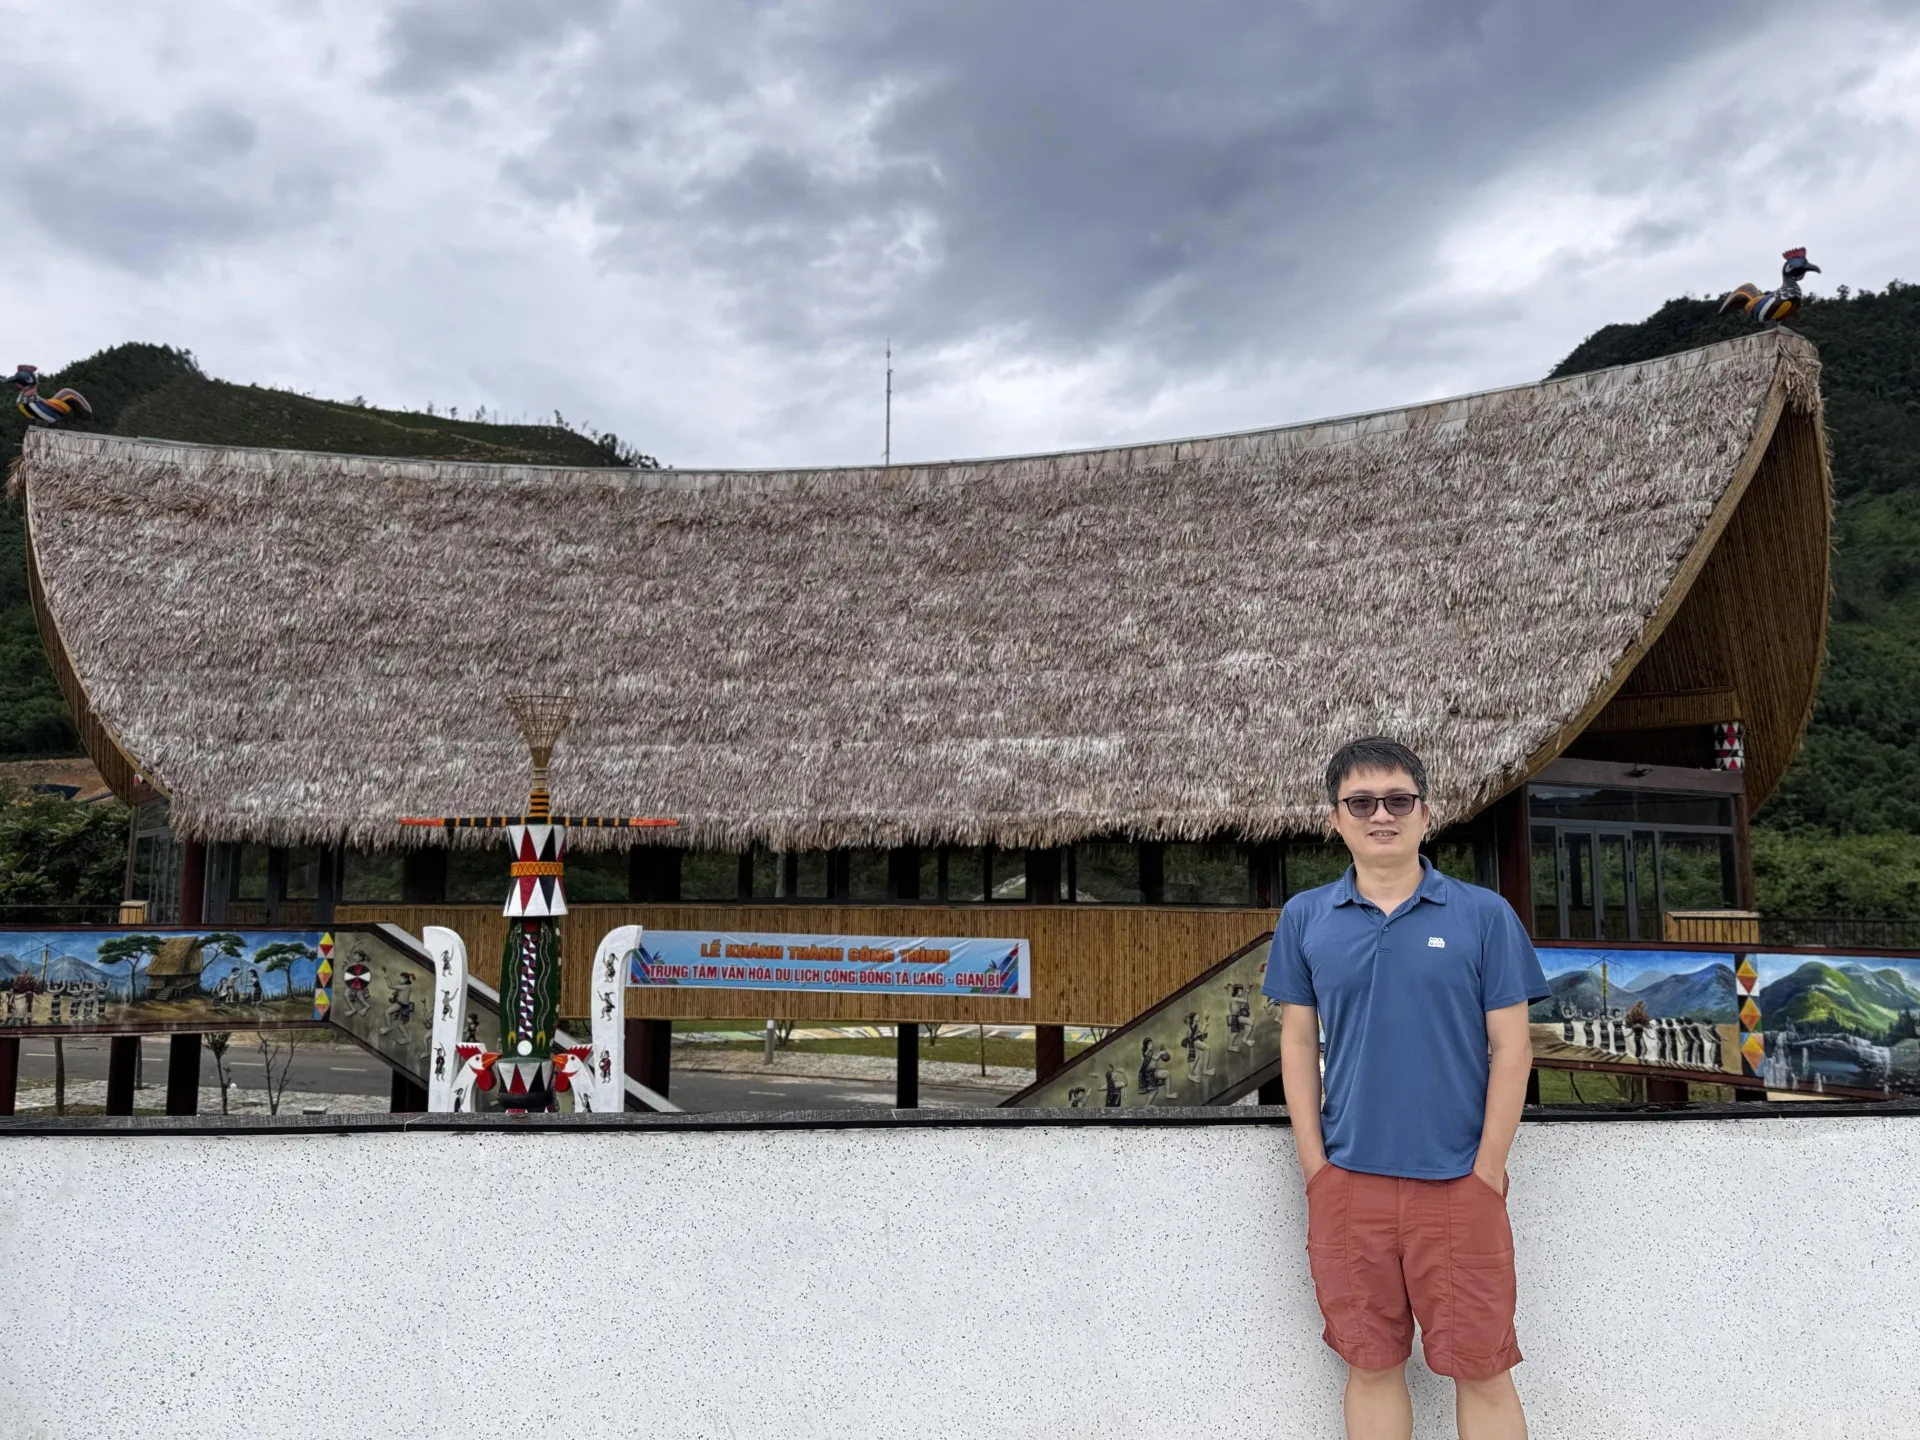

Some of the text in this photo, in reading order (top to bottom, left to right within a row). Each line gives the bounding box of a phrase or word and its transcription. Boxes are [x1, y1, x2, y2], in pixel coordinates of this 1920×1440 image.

[725, 942, 784, 959] KHÁNH
[787, 944, 844, 961] THÀNH
[848, 945, 895, 963] CÔNG
[899, 946, 951, 964] TRÌNH
[649, 964, 689, 979] TRUNG
[692, 963, 718, 979] TÂM
[721, 964, 745, 980] VĂN
[775, 968, 791, 982] DU
[794, 968, 820, 986] LỊCH
[824, 968, 856, 986] CỘNG
[859, 967, 892, 985] ĐỒNG
[913, 971, 944, 986] LANG
